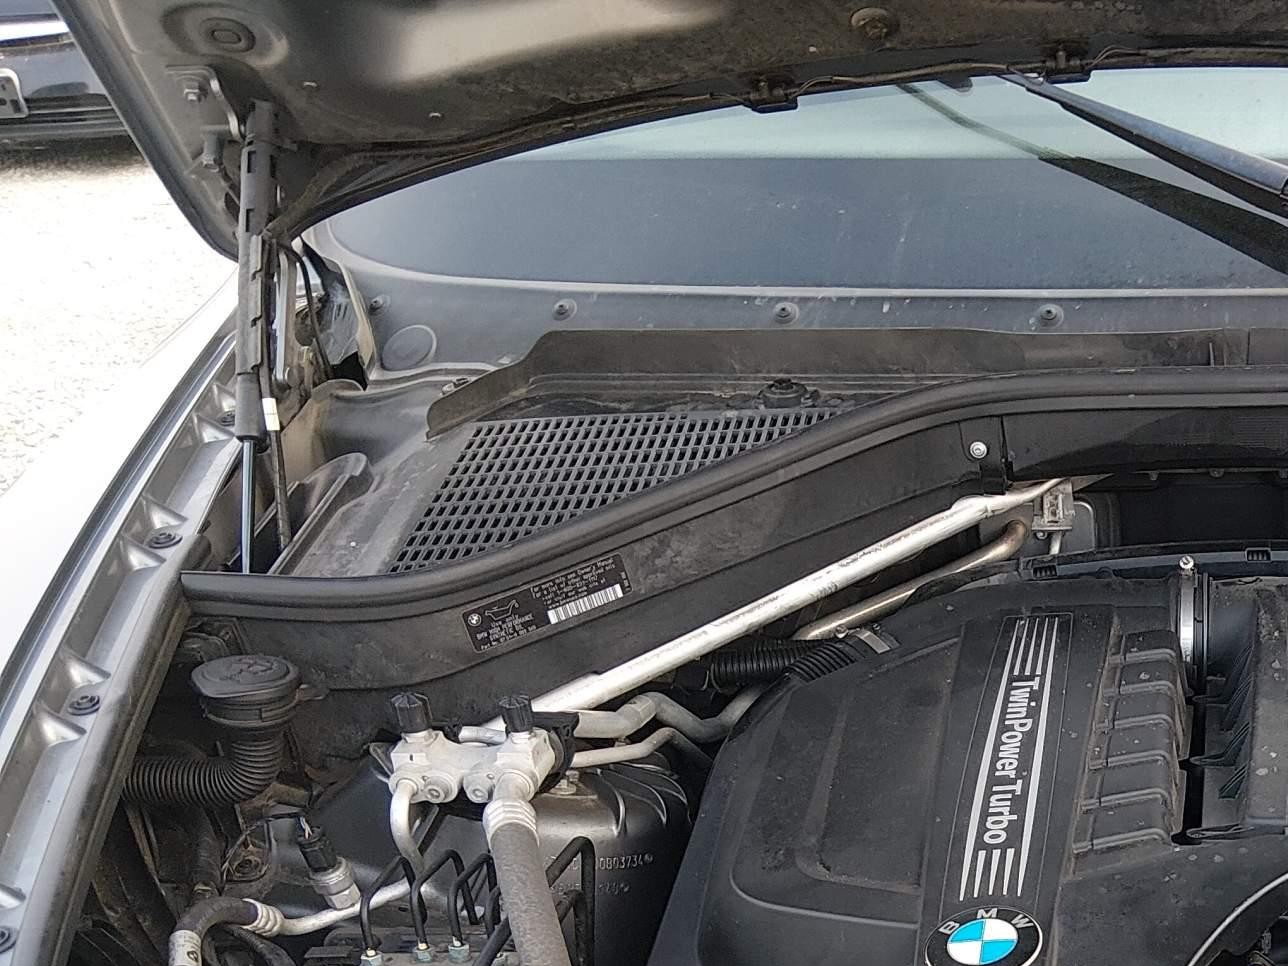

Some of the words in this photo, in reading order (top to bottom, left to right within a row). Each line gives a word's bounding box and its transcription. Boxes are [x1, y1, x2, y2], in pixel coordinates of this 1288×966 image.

[994, 676, 1040, 779] TwinPower
[983, 779, 1023, 845] Turbo
[938, 907, 1034, 935] BMW
